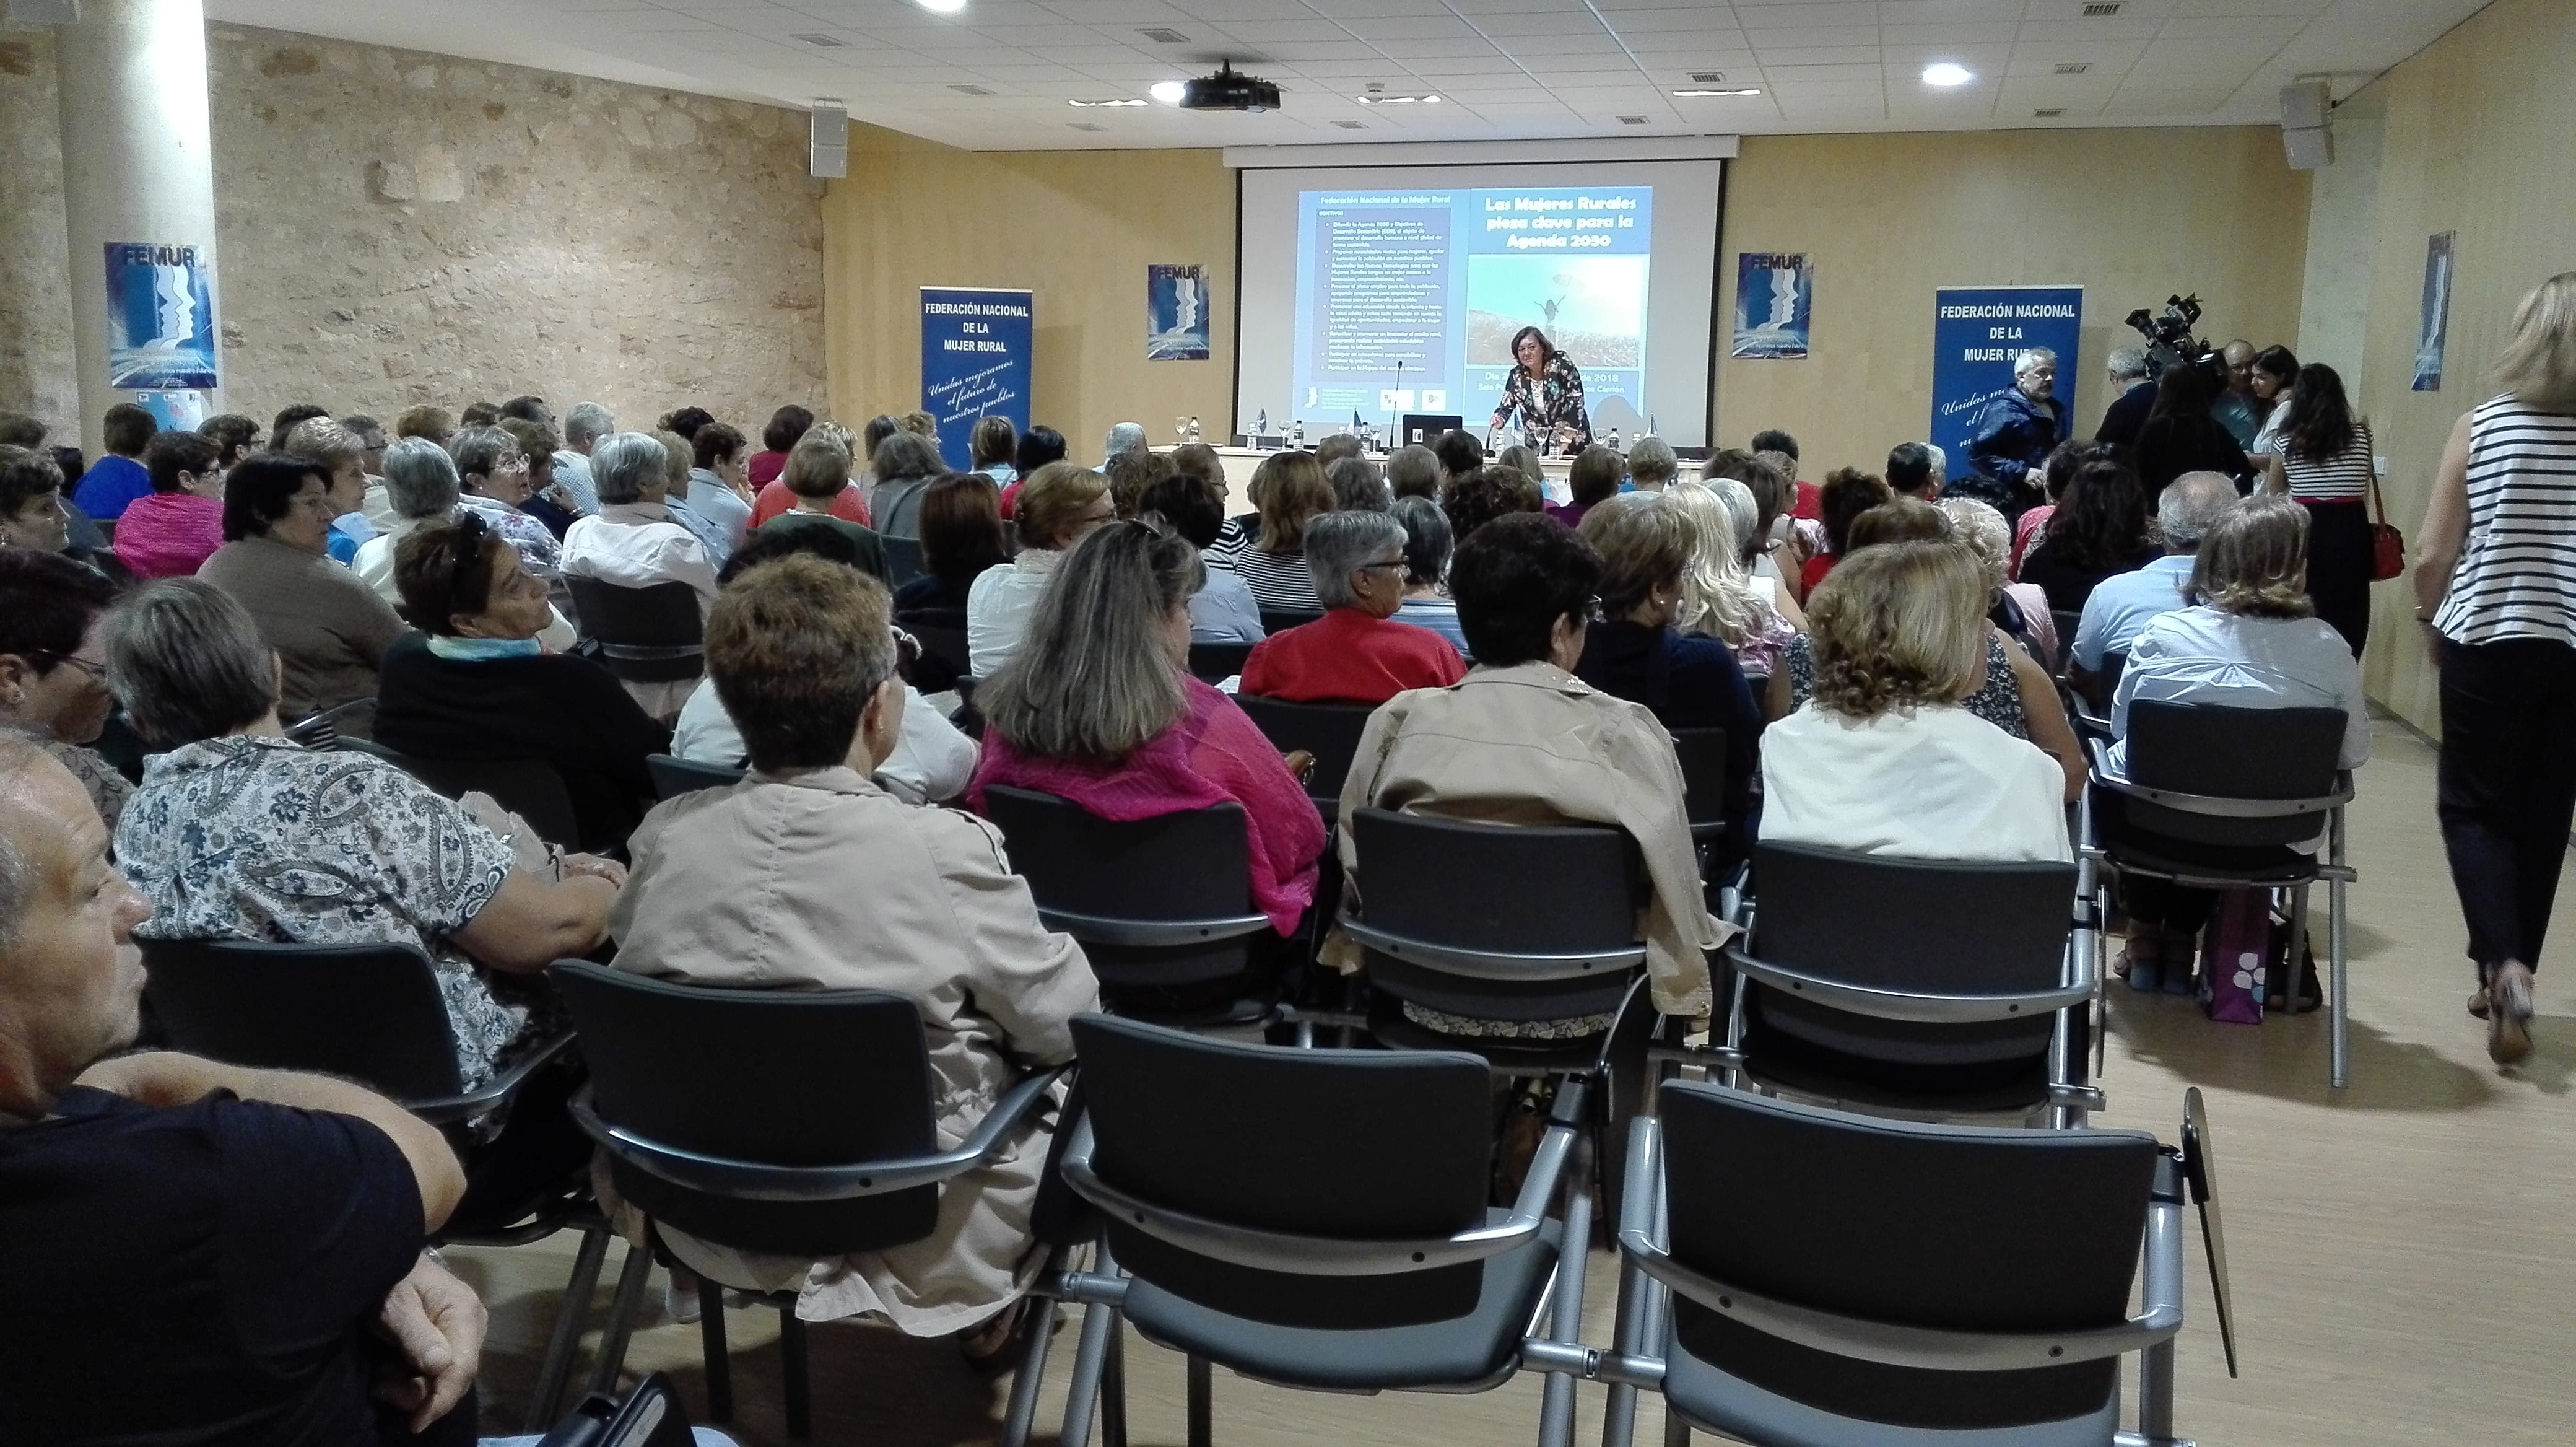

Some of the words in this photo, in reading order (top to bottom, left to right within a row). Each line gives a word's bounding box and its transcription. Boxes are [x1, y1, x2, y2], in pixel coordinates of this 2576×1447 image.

[1485, 198, 1511, 211] Las
[1515, 197, 1573, 214] Mujeres
[1577, 196, 1637, 211] Rurales
[1486, 216, 1528, 232] pieza
[1531, 216, 1573, 229] clave
[1576, 217, 1614, 231] para
[1618, 214, 1634, 229] la
[1506, 234, 1567, 249] Agenda
[1570, 234, 1611, 247] 2030
[123, 246, 195, 267] FEMUR
[1752, 255, 1803, 269] FEMUR
[1159, 266, 1200, 279] FEMUR
[925, 302, 980, 315] FEDERACIÓN
[983, 304, 1029, 317] NACIONAL
[1941, 303, 2012, 318] FEDERACIÓN
[2016, 305, 2075, 318] NACIONAL
[963, 322, 975, 333] DE
[977, 323, 989, 334] LA
[1990, 327, 2005, 339] DE
[2008, 327, 2022, 339] LA
[944, 339, 975, 352] MUJER
[977, 340, 1006, 352] RURAL
[1964, 349, 2004, 361] MUJER
[928, 377, 962, 396] Unidas
[965, 359, 1013, 388] mejoramos
[1594, 374, 1619, 382] 2018
[947, 389, 957, 406] el
[955, 385, 985, 411] futuro
[986, 378, 996, 392] de
[943, 406, 980, 423] nuestros
[980, 387, 1016, 418] pueblos
[1941, 392, 1986, 416] Unidas
[1966, 410, 1978, 426] el
